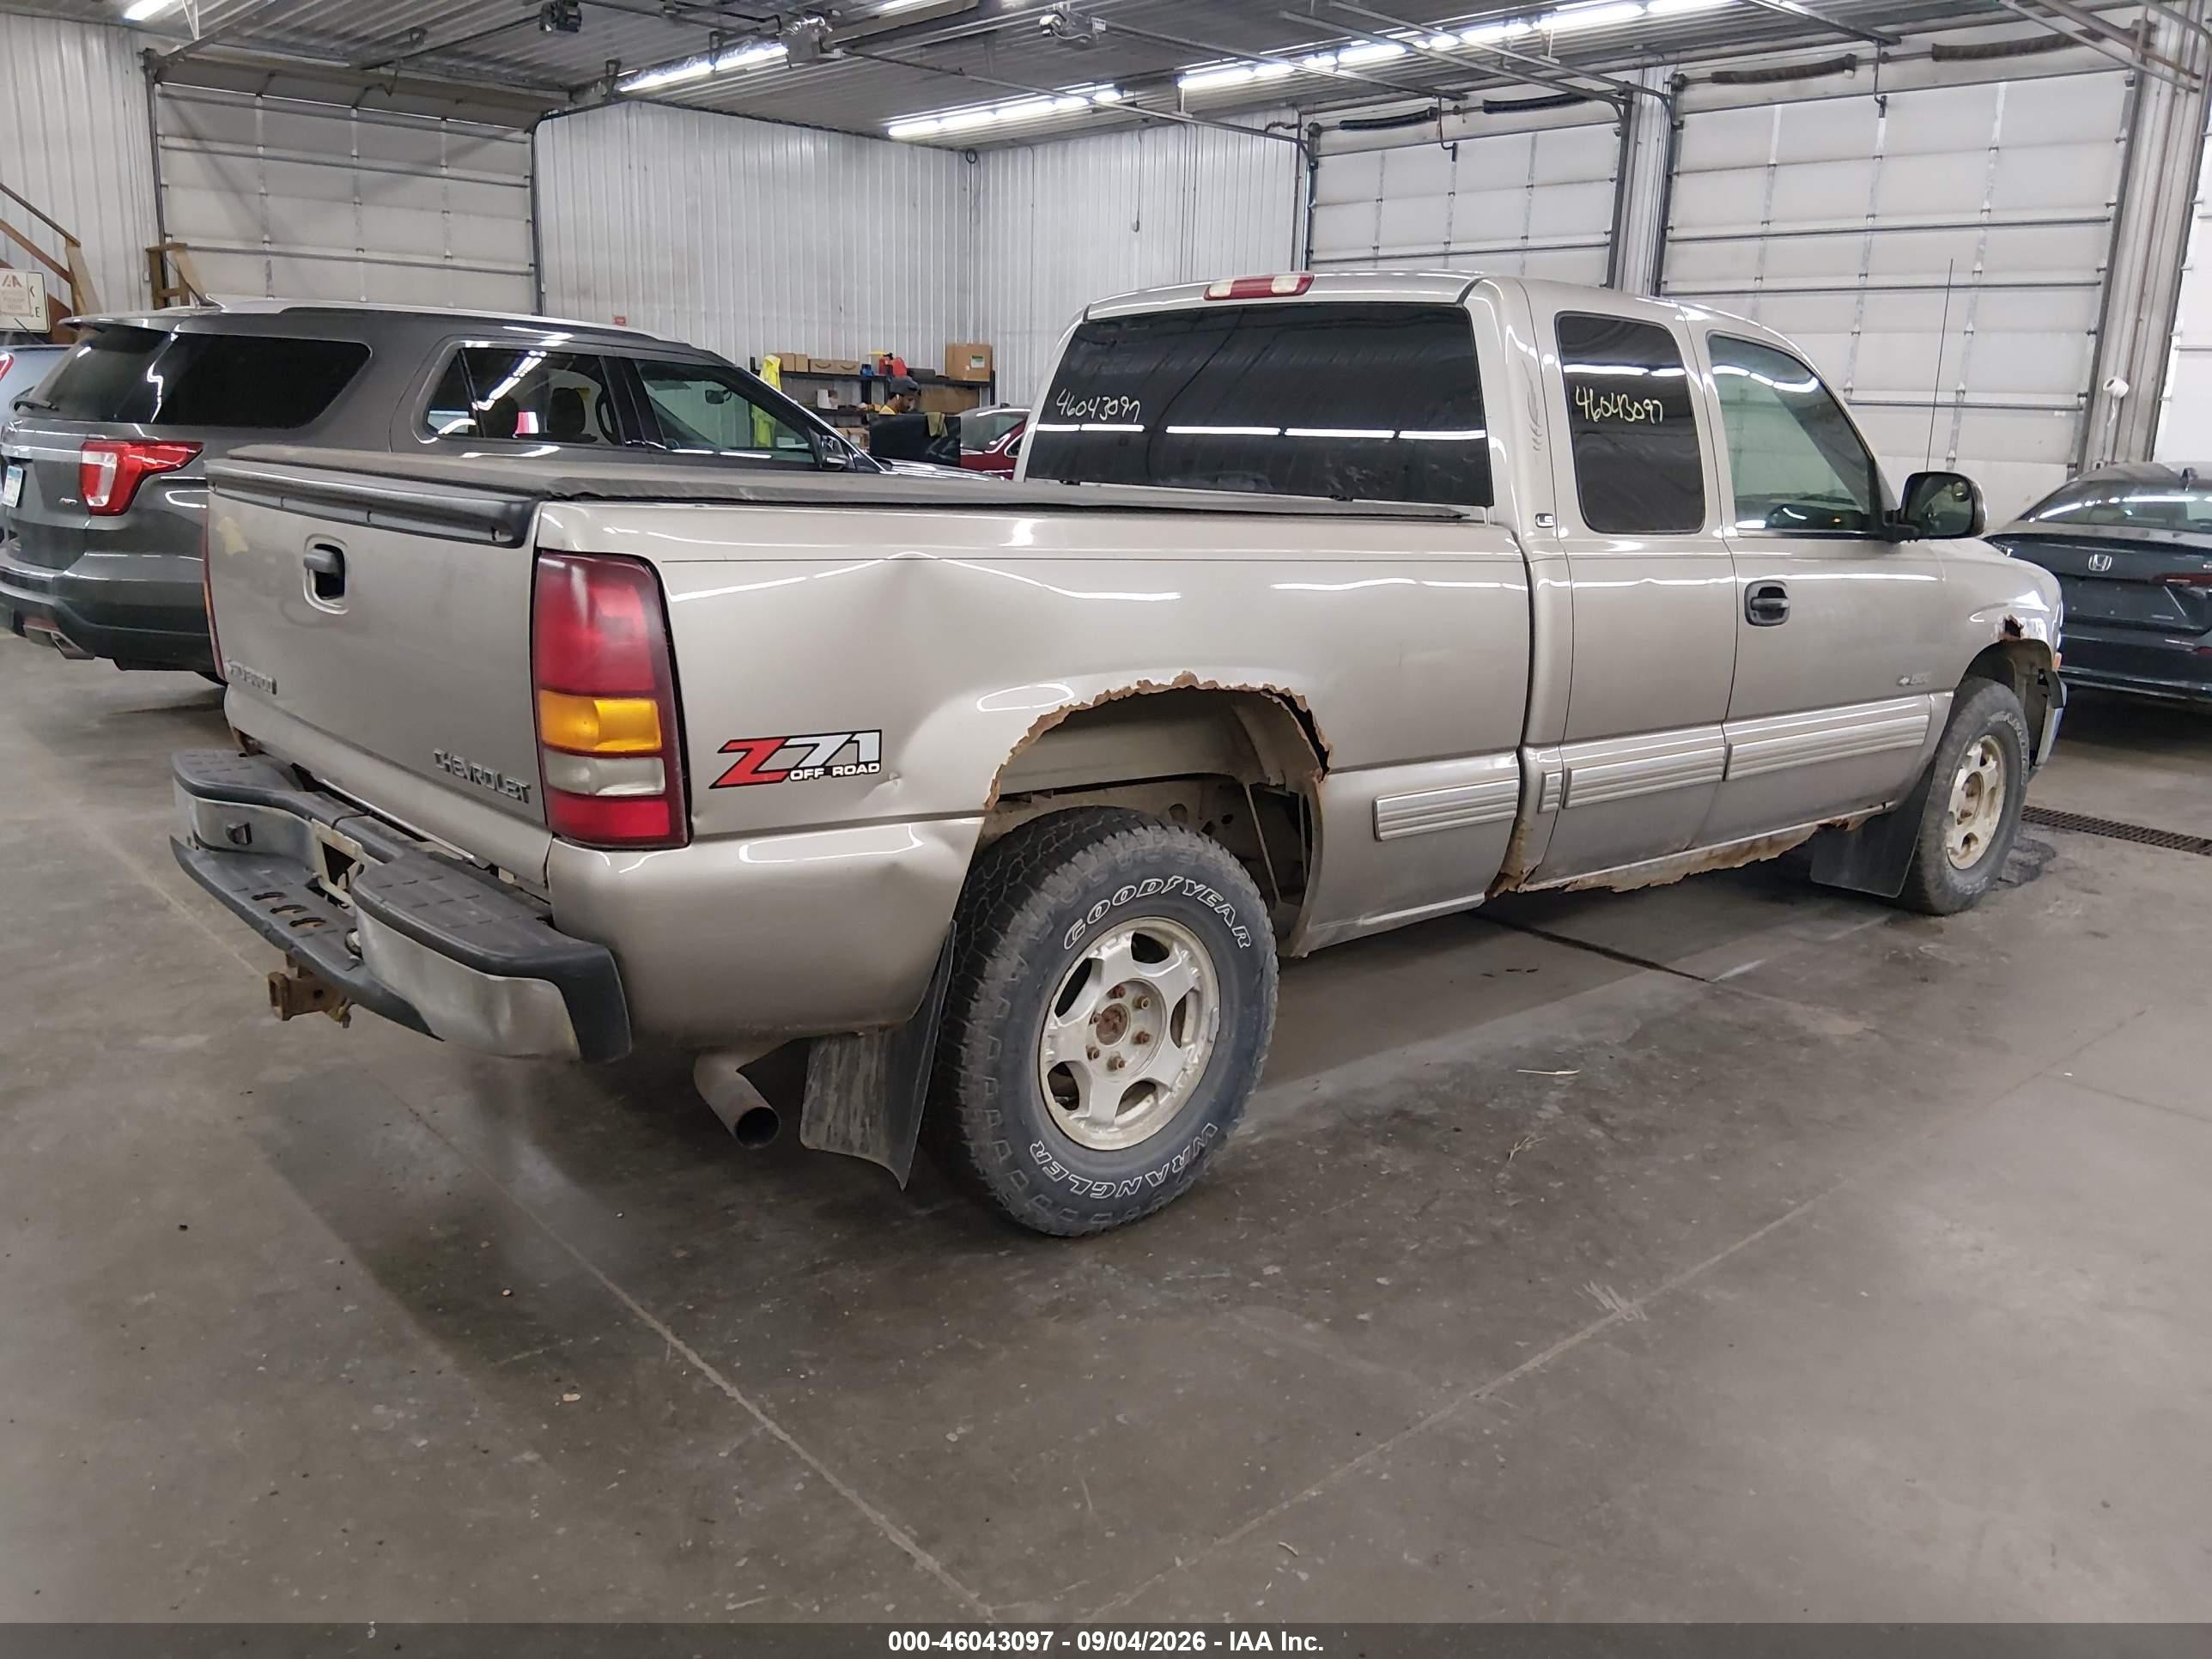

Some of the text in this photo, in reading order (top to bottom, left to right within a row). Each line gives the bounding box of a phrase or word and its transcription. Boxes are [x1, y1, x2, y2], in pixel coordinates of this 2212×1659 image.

[1056, 388, 1140, 423] 46043097
[1576, 385, 1663, 424] 46043097
[708, 729, 882, 789] Z71
[789, 763, 880, 781] OFF ROAD
[1064, 874, 1251, 950] GOODYEAR
[1030, 1122, 1218, 1199] WRANGLER
